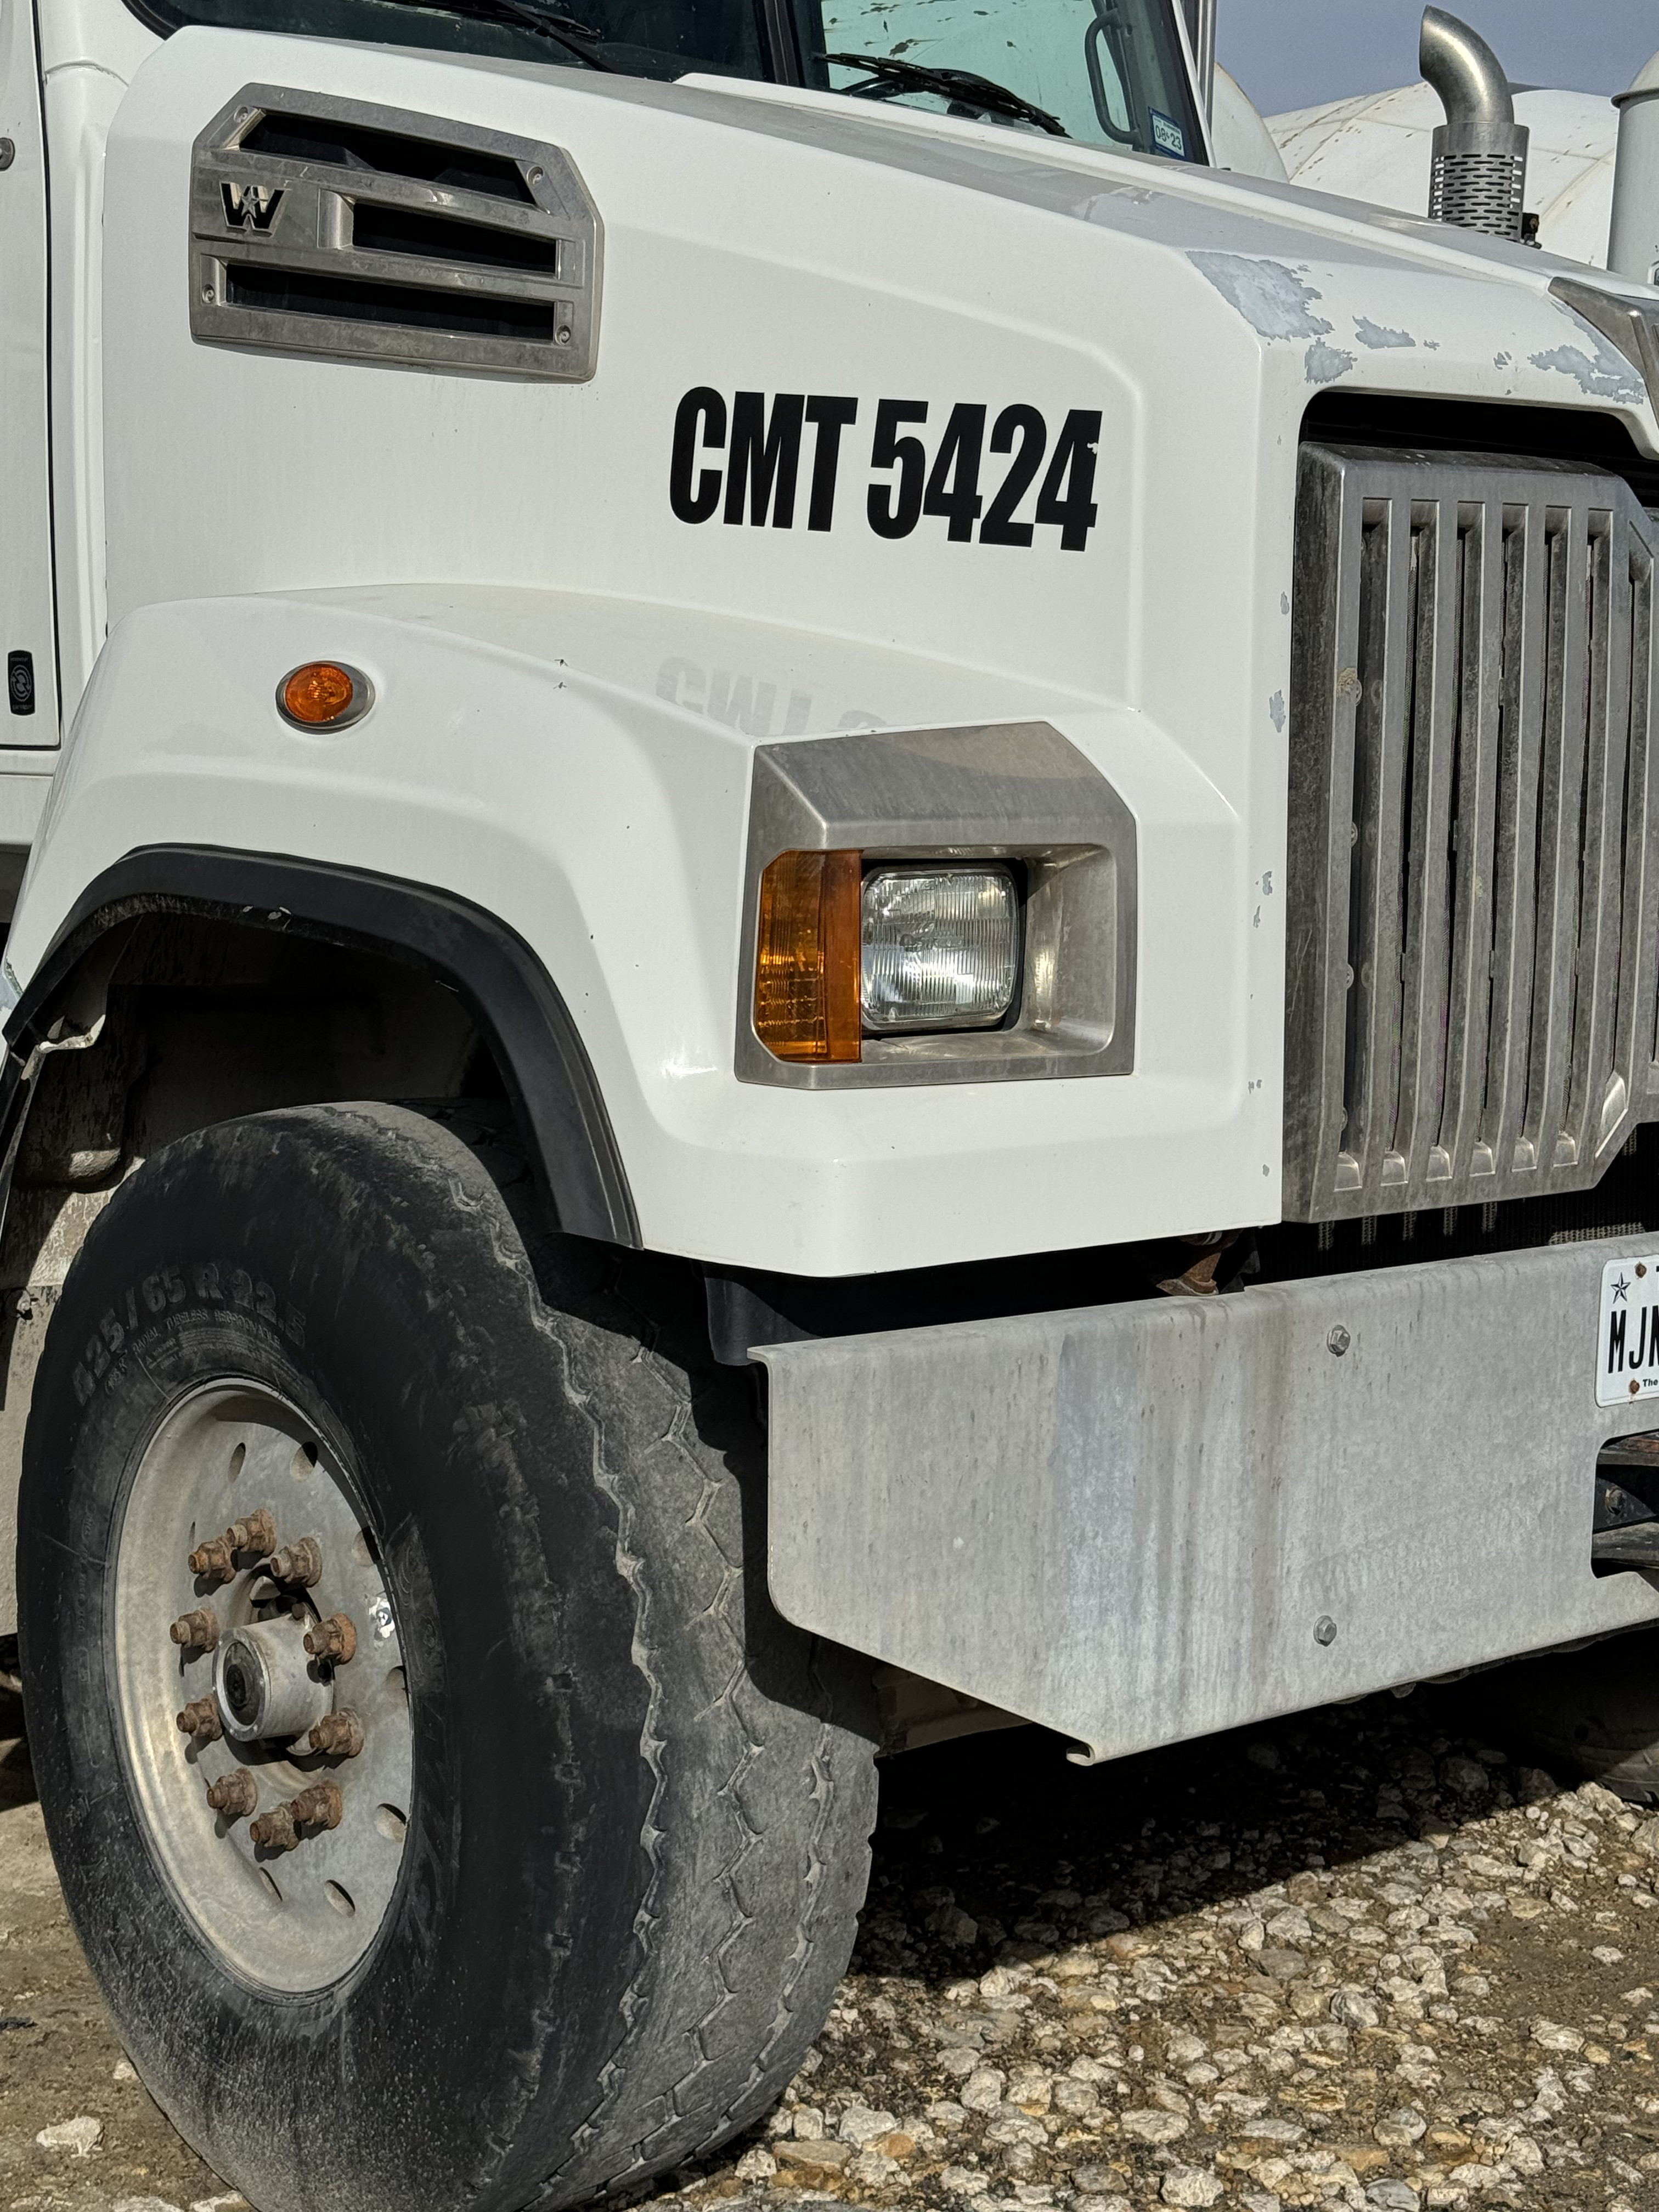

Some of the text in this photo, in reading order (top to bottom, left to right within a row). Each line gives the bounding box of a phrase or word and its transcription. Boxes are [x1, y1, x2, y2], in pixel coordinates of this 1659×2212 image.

[1155, 125, 1167, 142] 08
[1170, 133, 1182, 150] 23
[669, 386, 1103, 552] CMT 5424
[1643, 1379, 1658, 1387] The
